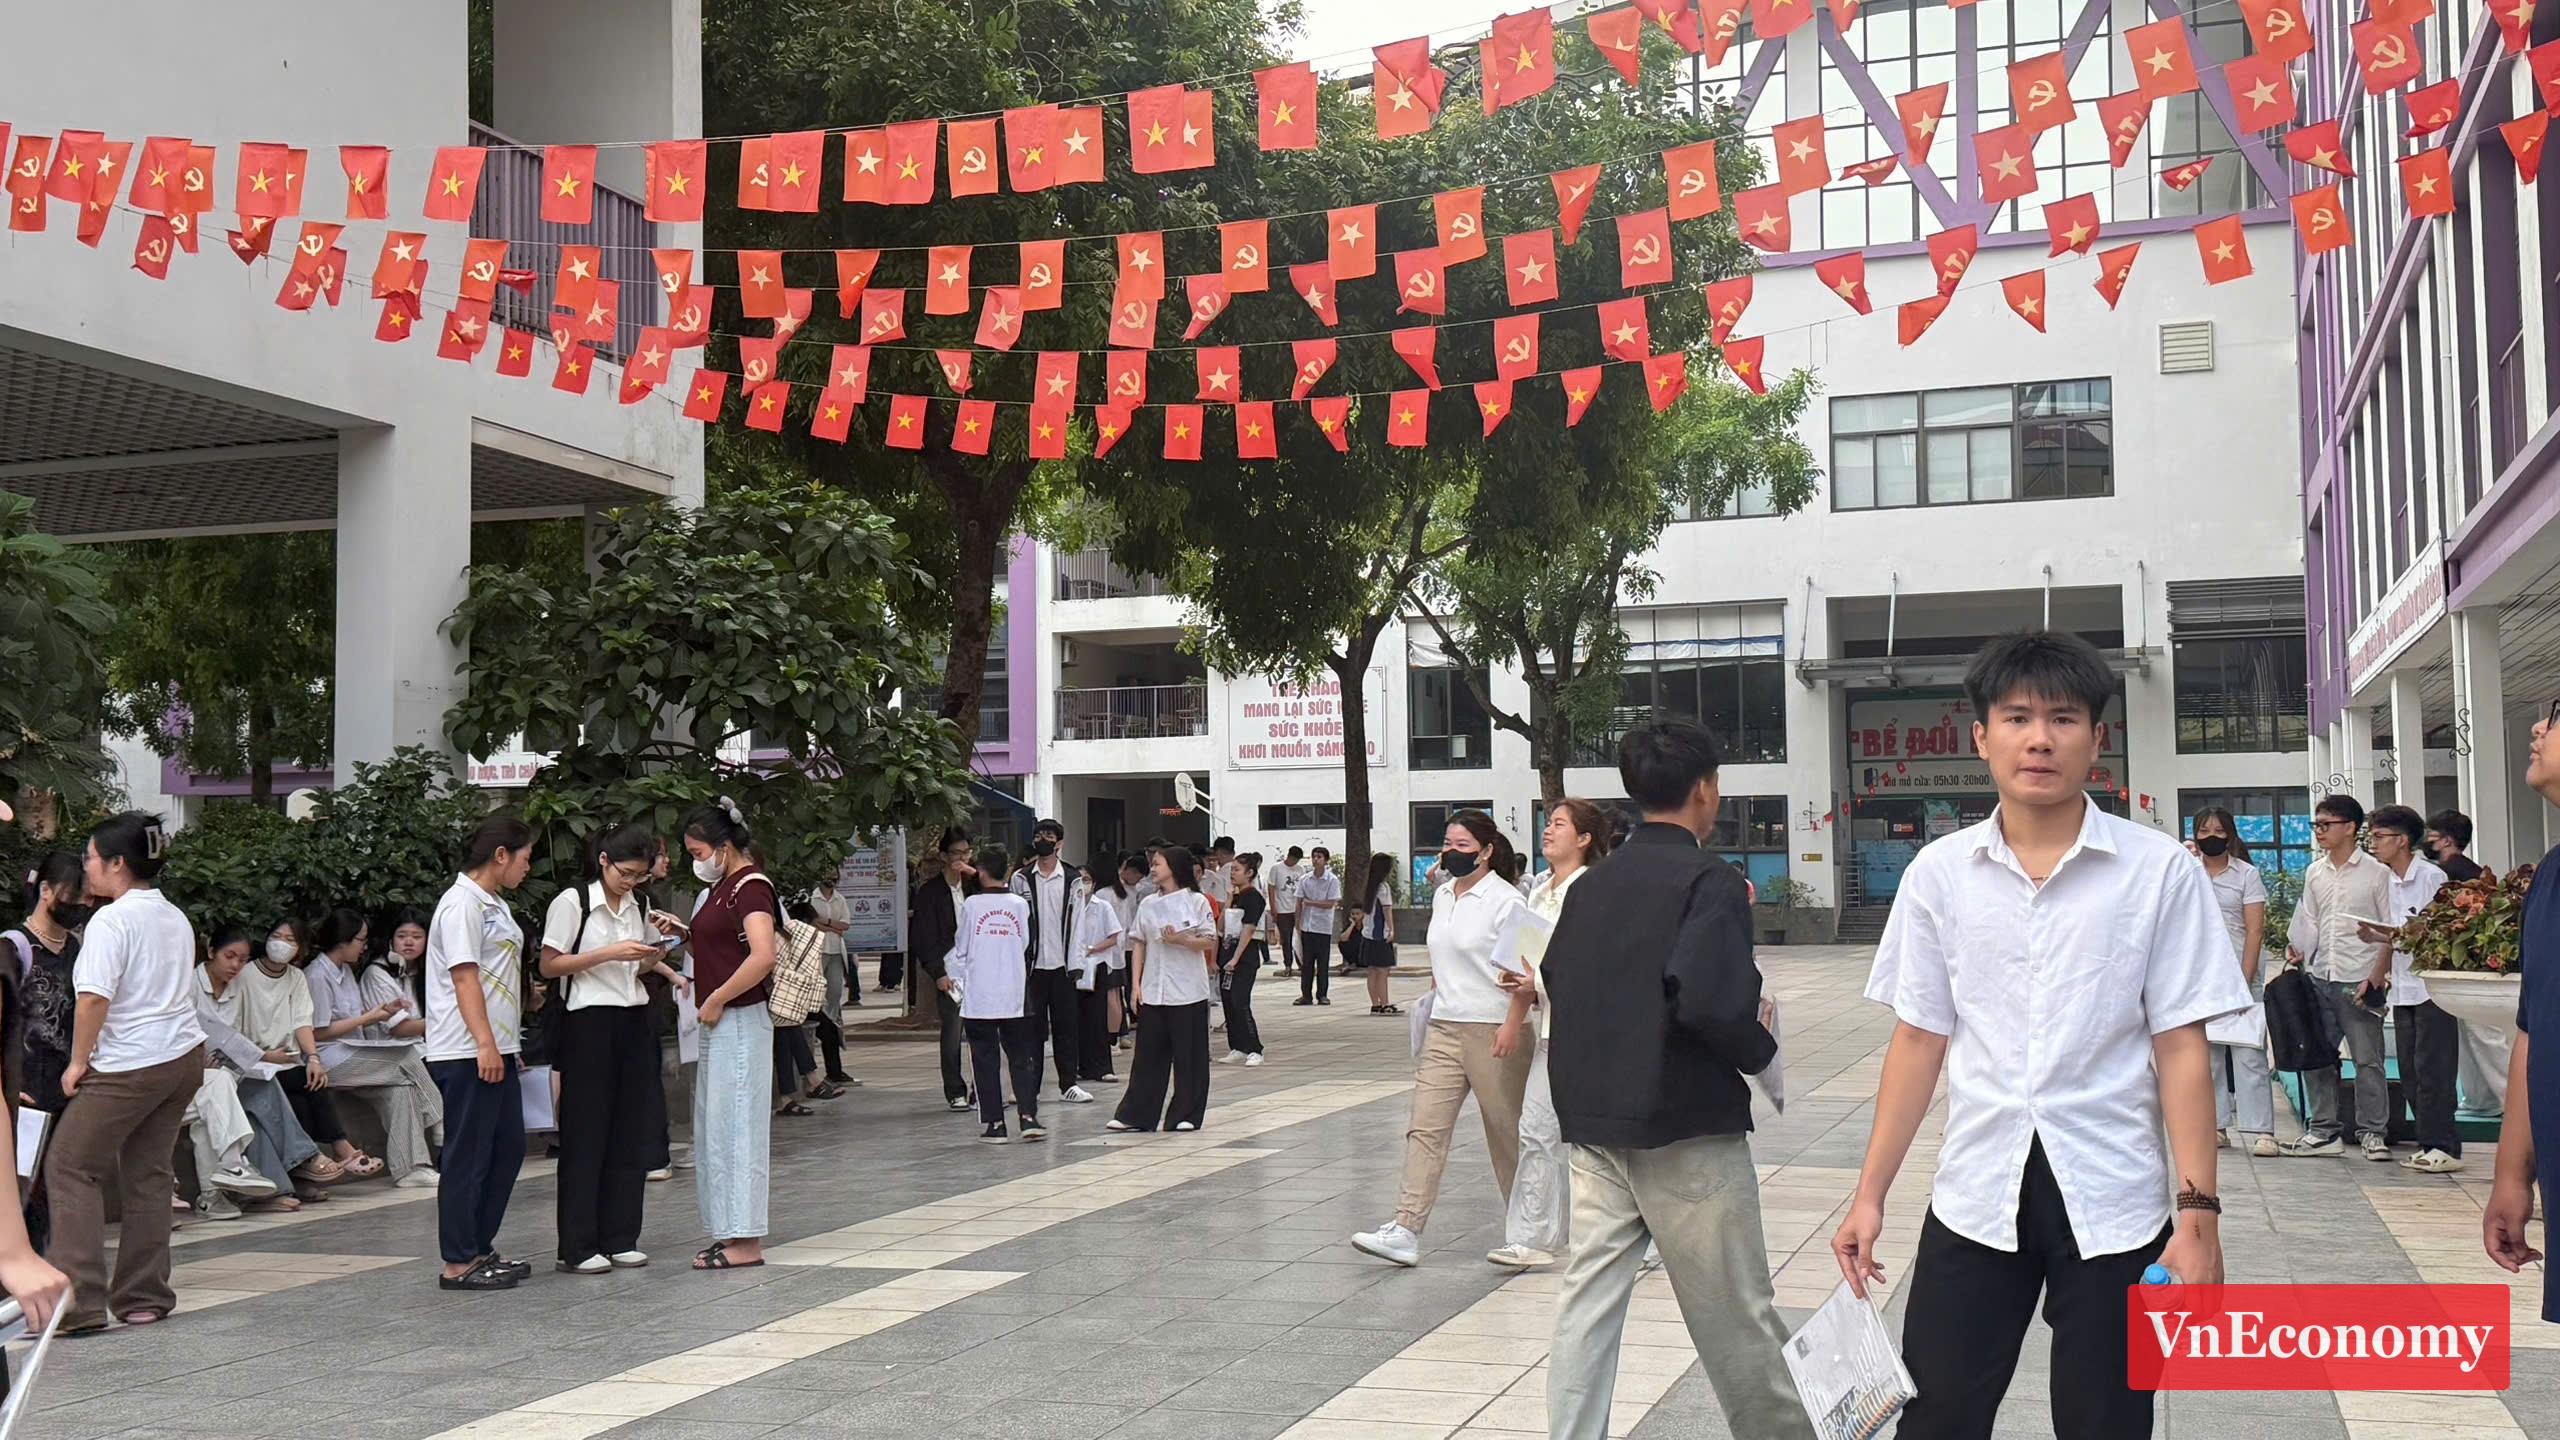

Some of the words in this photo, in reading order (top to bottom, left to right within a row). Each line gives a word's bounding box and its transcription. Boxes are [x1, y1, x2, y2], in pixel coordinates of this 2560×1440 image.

[1243, 702, 1280, 718] MANG
[1284, 701, 1303, 719] LẠI
[1308, 698, 1333, 716] SỨC
[1268, 720, 1299, 738] SỨC
[1238, 743, 1267, 759] KHƠI
[1933, 774, 1959, 787] 05h30
